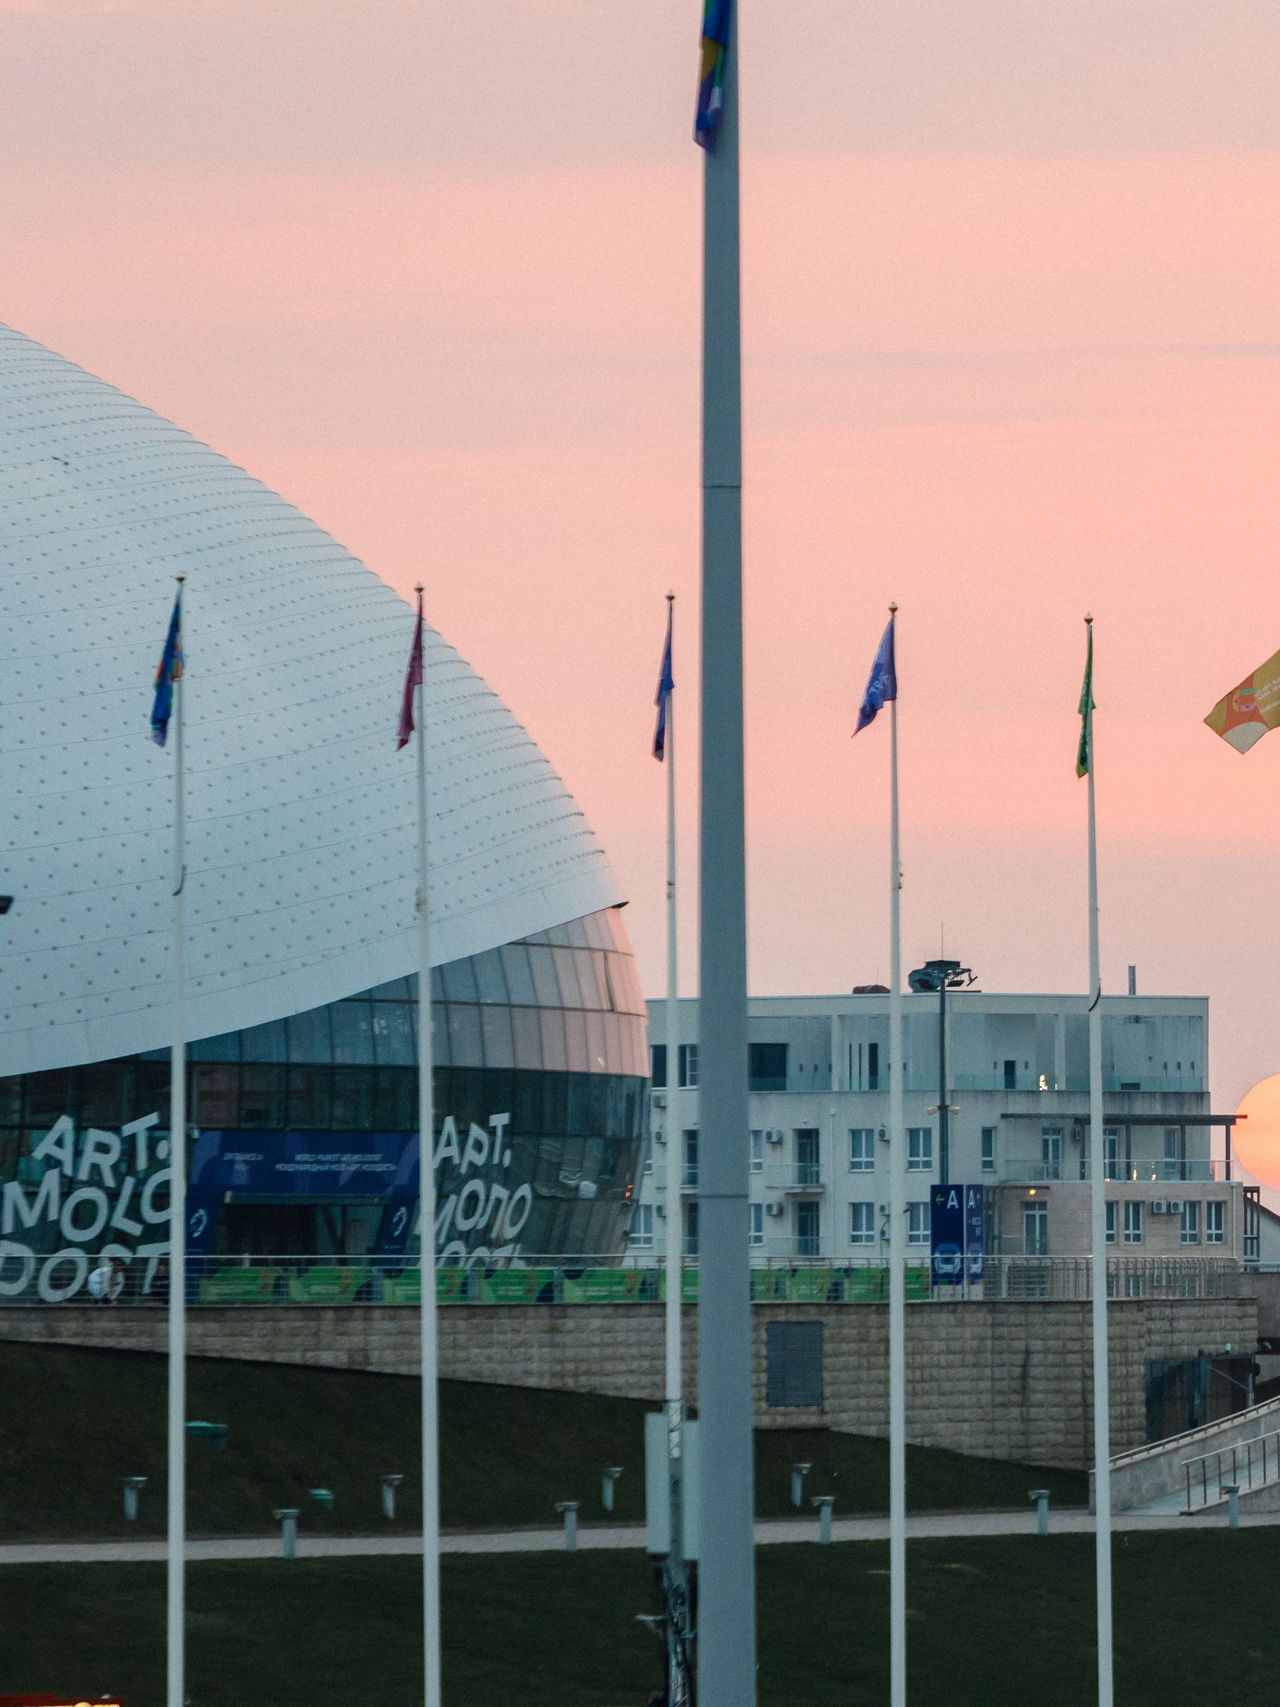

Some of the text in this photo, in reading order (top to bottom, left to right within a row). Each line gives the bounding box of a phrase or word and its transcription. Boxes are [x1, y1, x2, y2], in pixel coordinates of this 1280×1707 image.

[31, 1111, 170, 1188] ART.
[3, 1167, 171, 1242] MOLO
[946, 1190, 959, 1209] A
[967, 1190, 975, 1209] A
